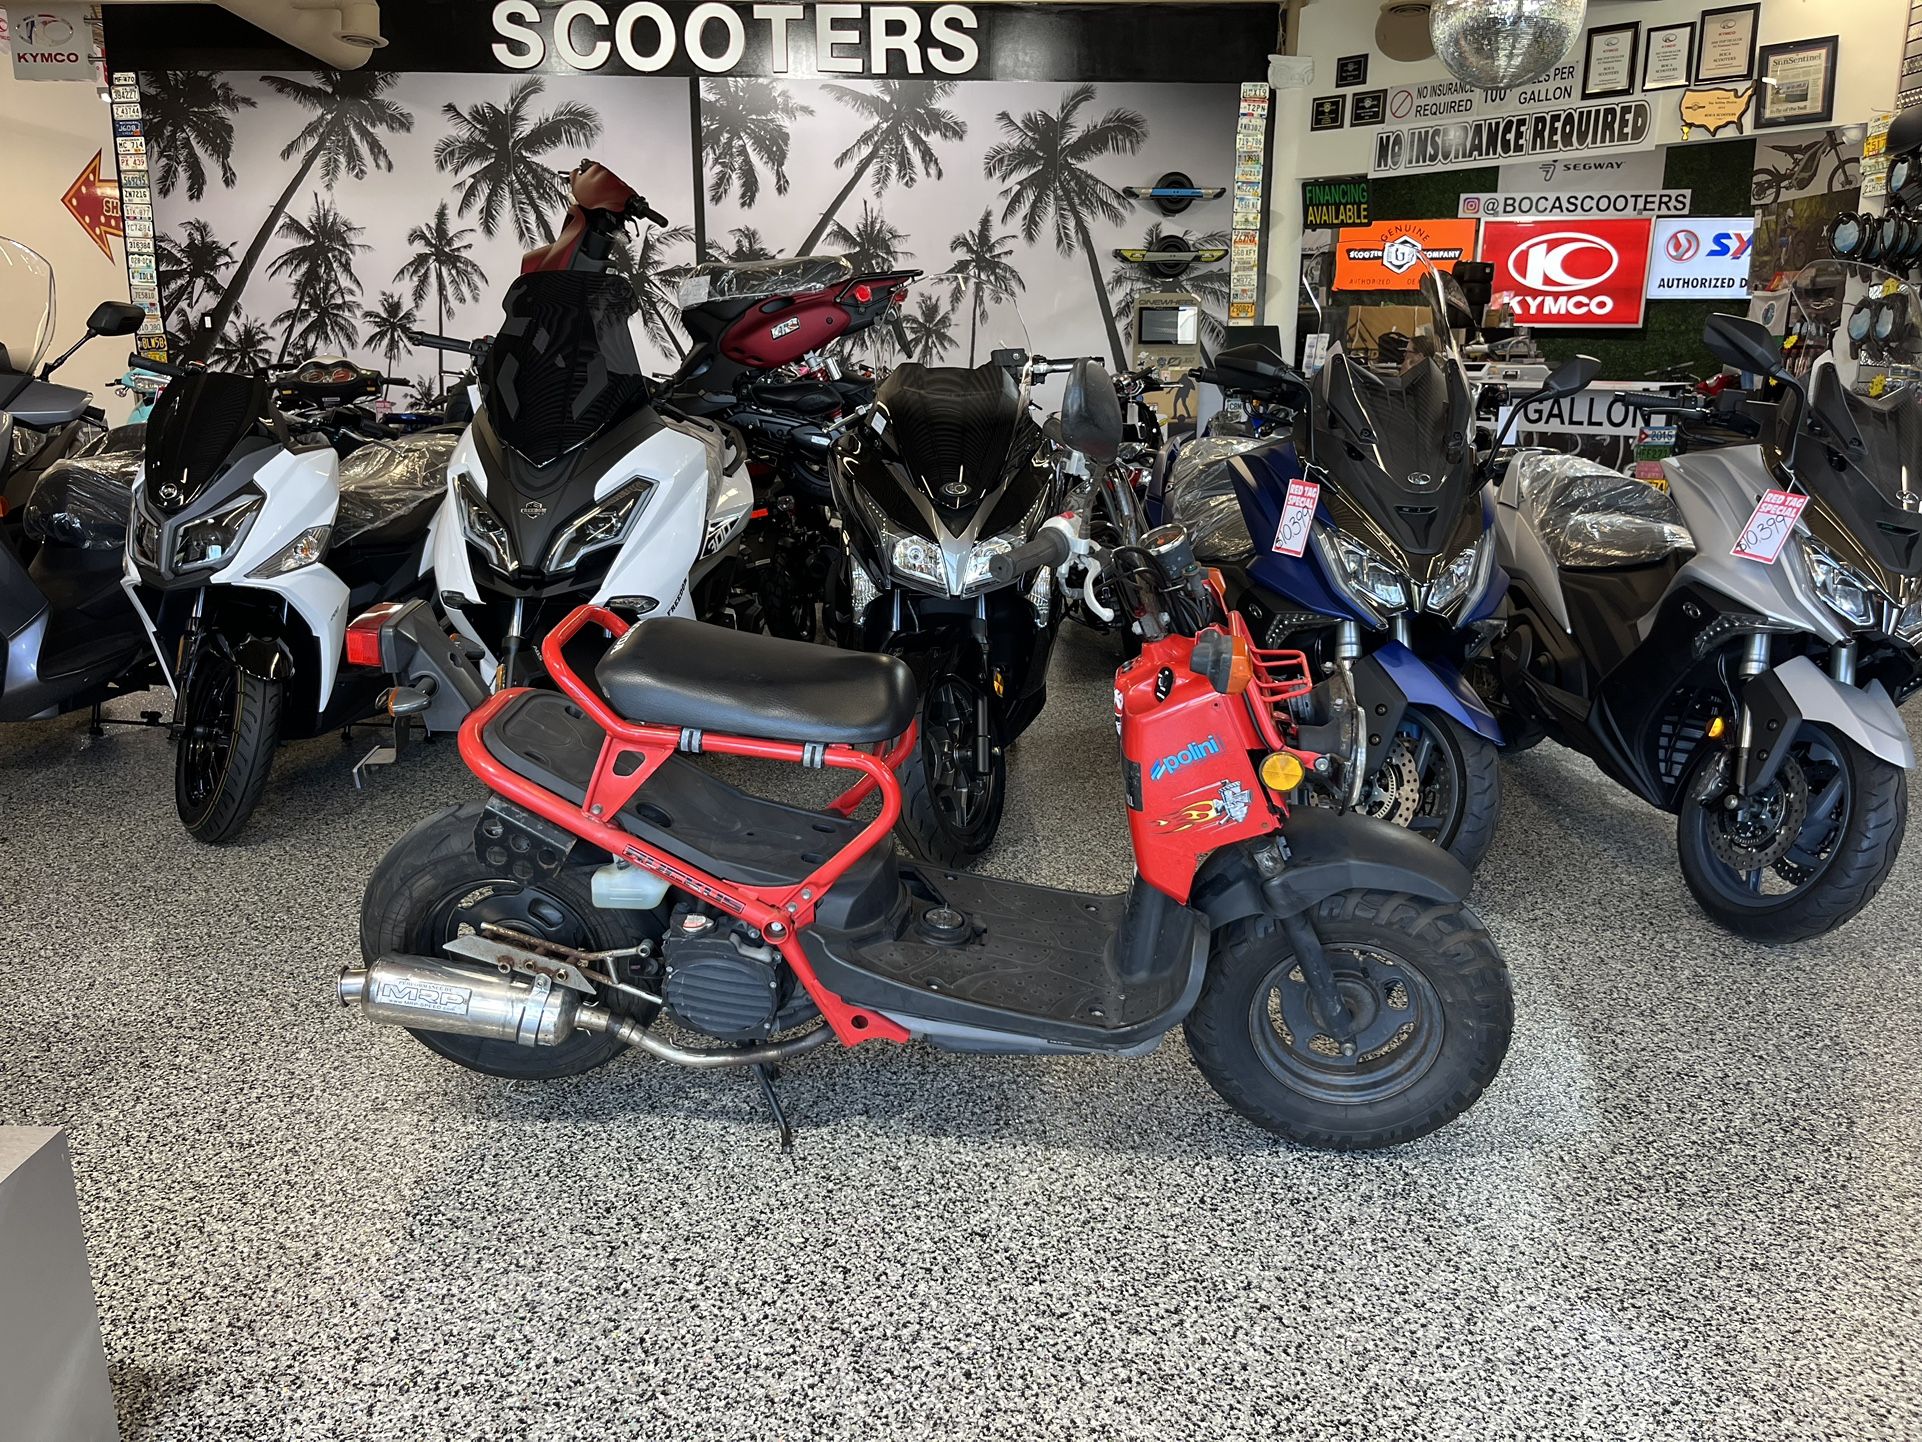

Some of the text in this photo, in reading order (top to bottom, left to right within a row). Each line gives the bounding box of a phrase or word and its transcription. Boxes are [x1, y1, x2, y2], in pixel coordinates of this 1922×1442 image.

[491, 0, 979, 75] SCOOTERS
[17, 52, 79, 63] KYMCO
[1554, 65, 1576, 81] PER
[1417, 81, 1475, 99] NO INSURANCE
[1518, 85, 1573, 105] GALLON
[1415, 99, 1473, 117] REQUIRED
[1376, 101, 1651, 171] NO INSURANCE REQUIRED
[1562, 161, 1624, 172] SEGWAY
[1305, 184, 1368, 204] FINANCING
[1306, 204, 1368, 224] AVAILABLE
[1380, 224, 1430, 242] GENUINE
[1657, 277, 1735, 289] AUTHORIZED
[1502, 295, 1614, 315] KYMCO
[1651, 430, 1673, 441] 2015
[1290, 484, 1318, 498] RED TAG
[1287, 495, 1315, 509] SPECIAL
[1765, 493, 1805, 508] RED TAG
[1759, 503, 1798, 517] SPECIAL
[381, 983, 465, 1006] MRP
